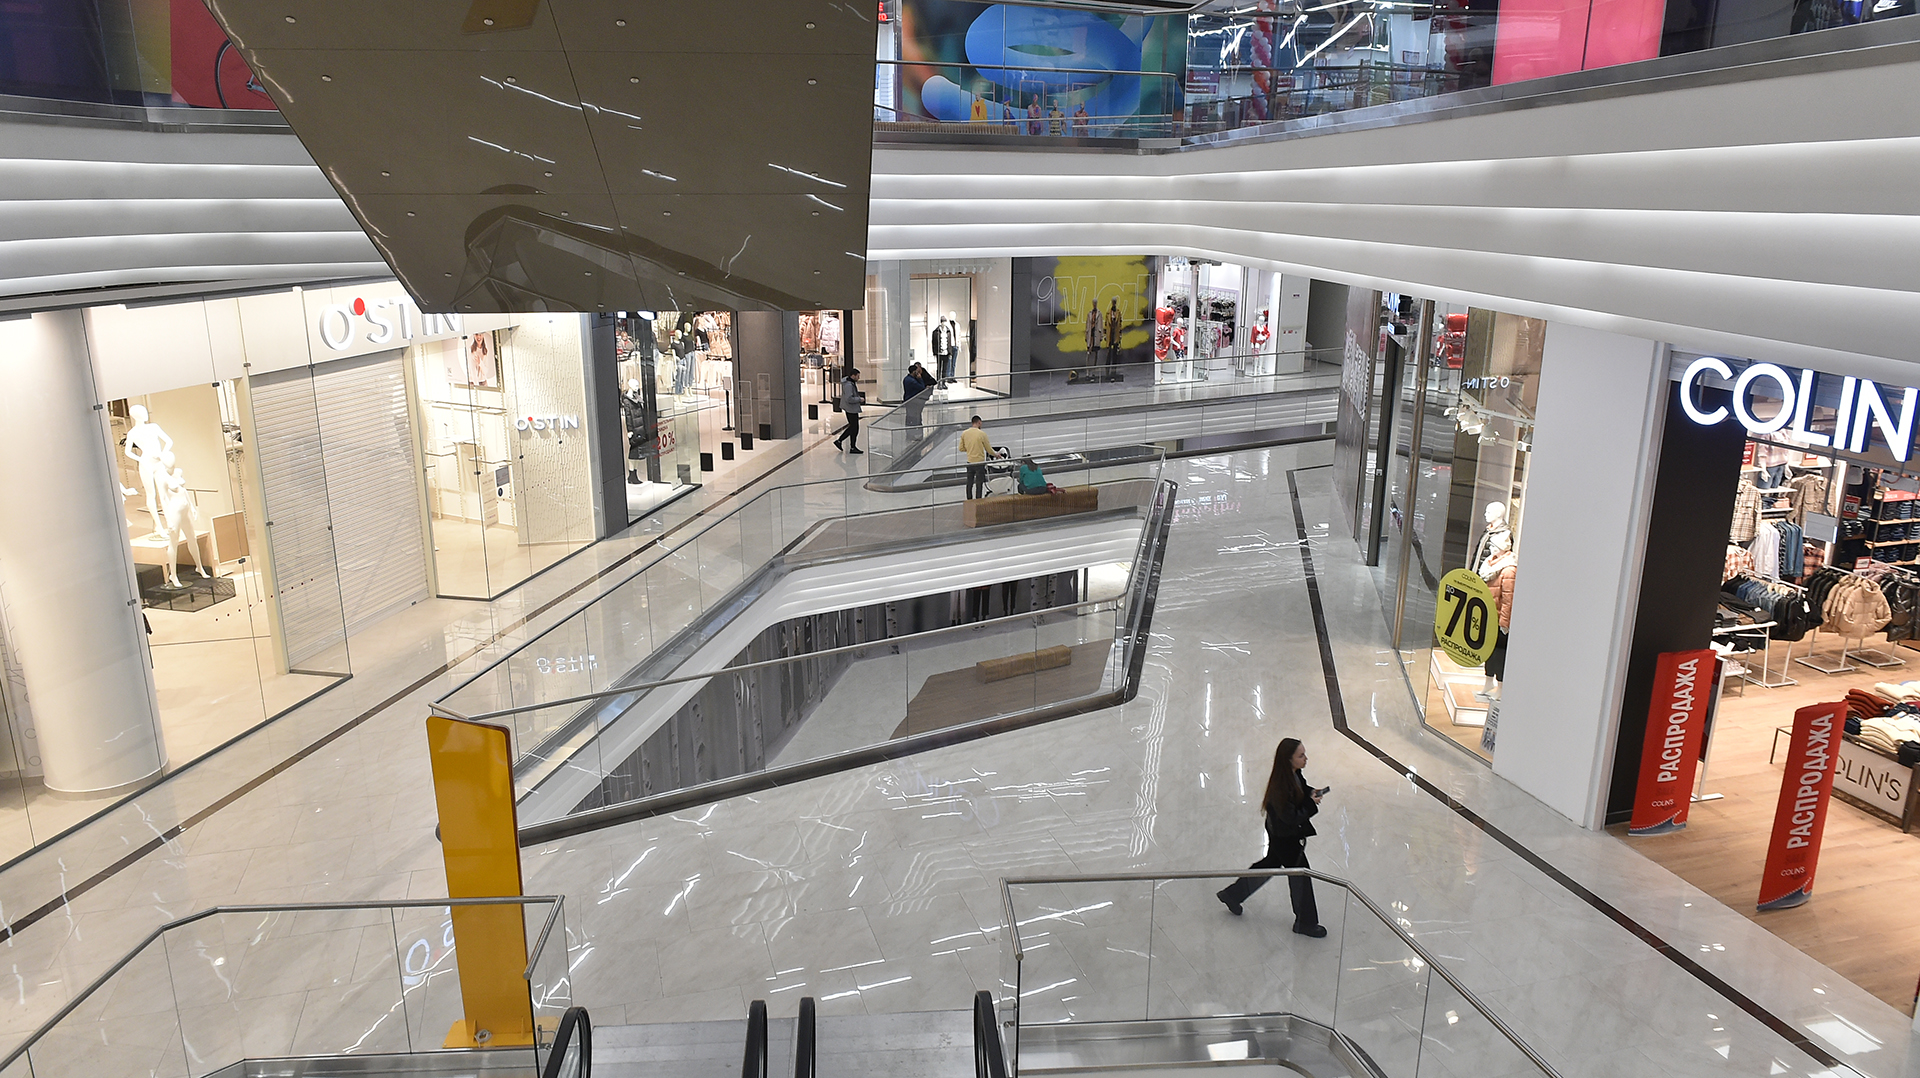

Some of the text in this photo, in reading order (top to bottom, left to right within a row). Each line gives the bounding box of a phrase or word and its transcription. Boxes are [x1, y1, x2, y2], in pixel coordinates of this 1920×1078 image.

[514, 415, 579, 431] O'STIN
[1680, 357, 1919, 462] COLIN
[1441, 637, 1481, 662] РАСПРОДАЖА
[1657, 658, 1699, 782] РАСПРОДАЖА
[1786, 713, 1834, 849] РАСПРОДАЖА
[1835, 754, 1902, 801] OLIN'S
